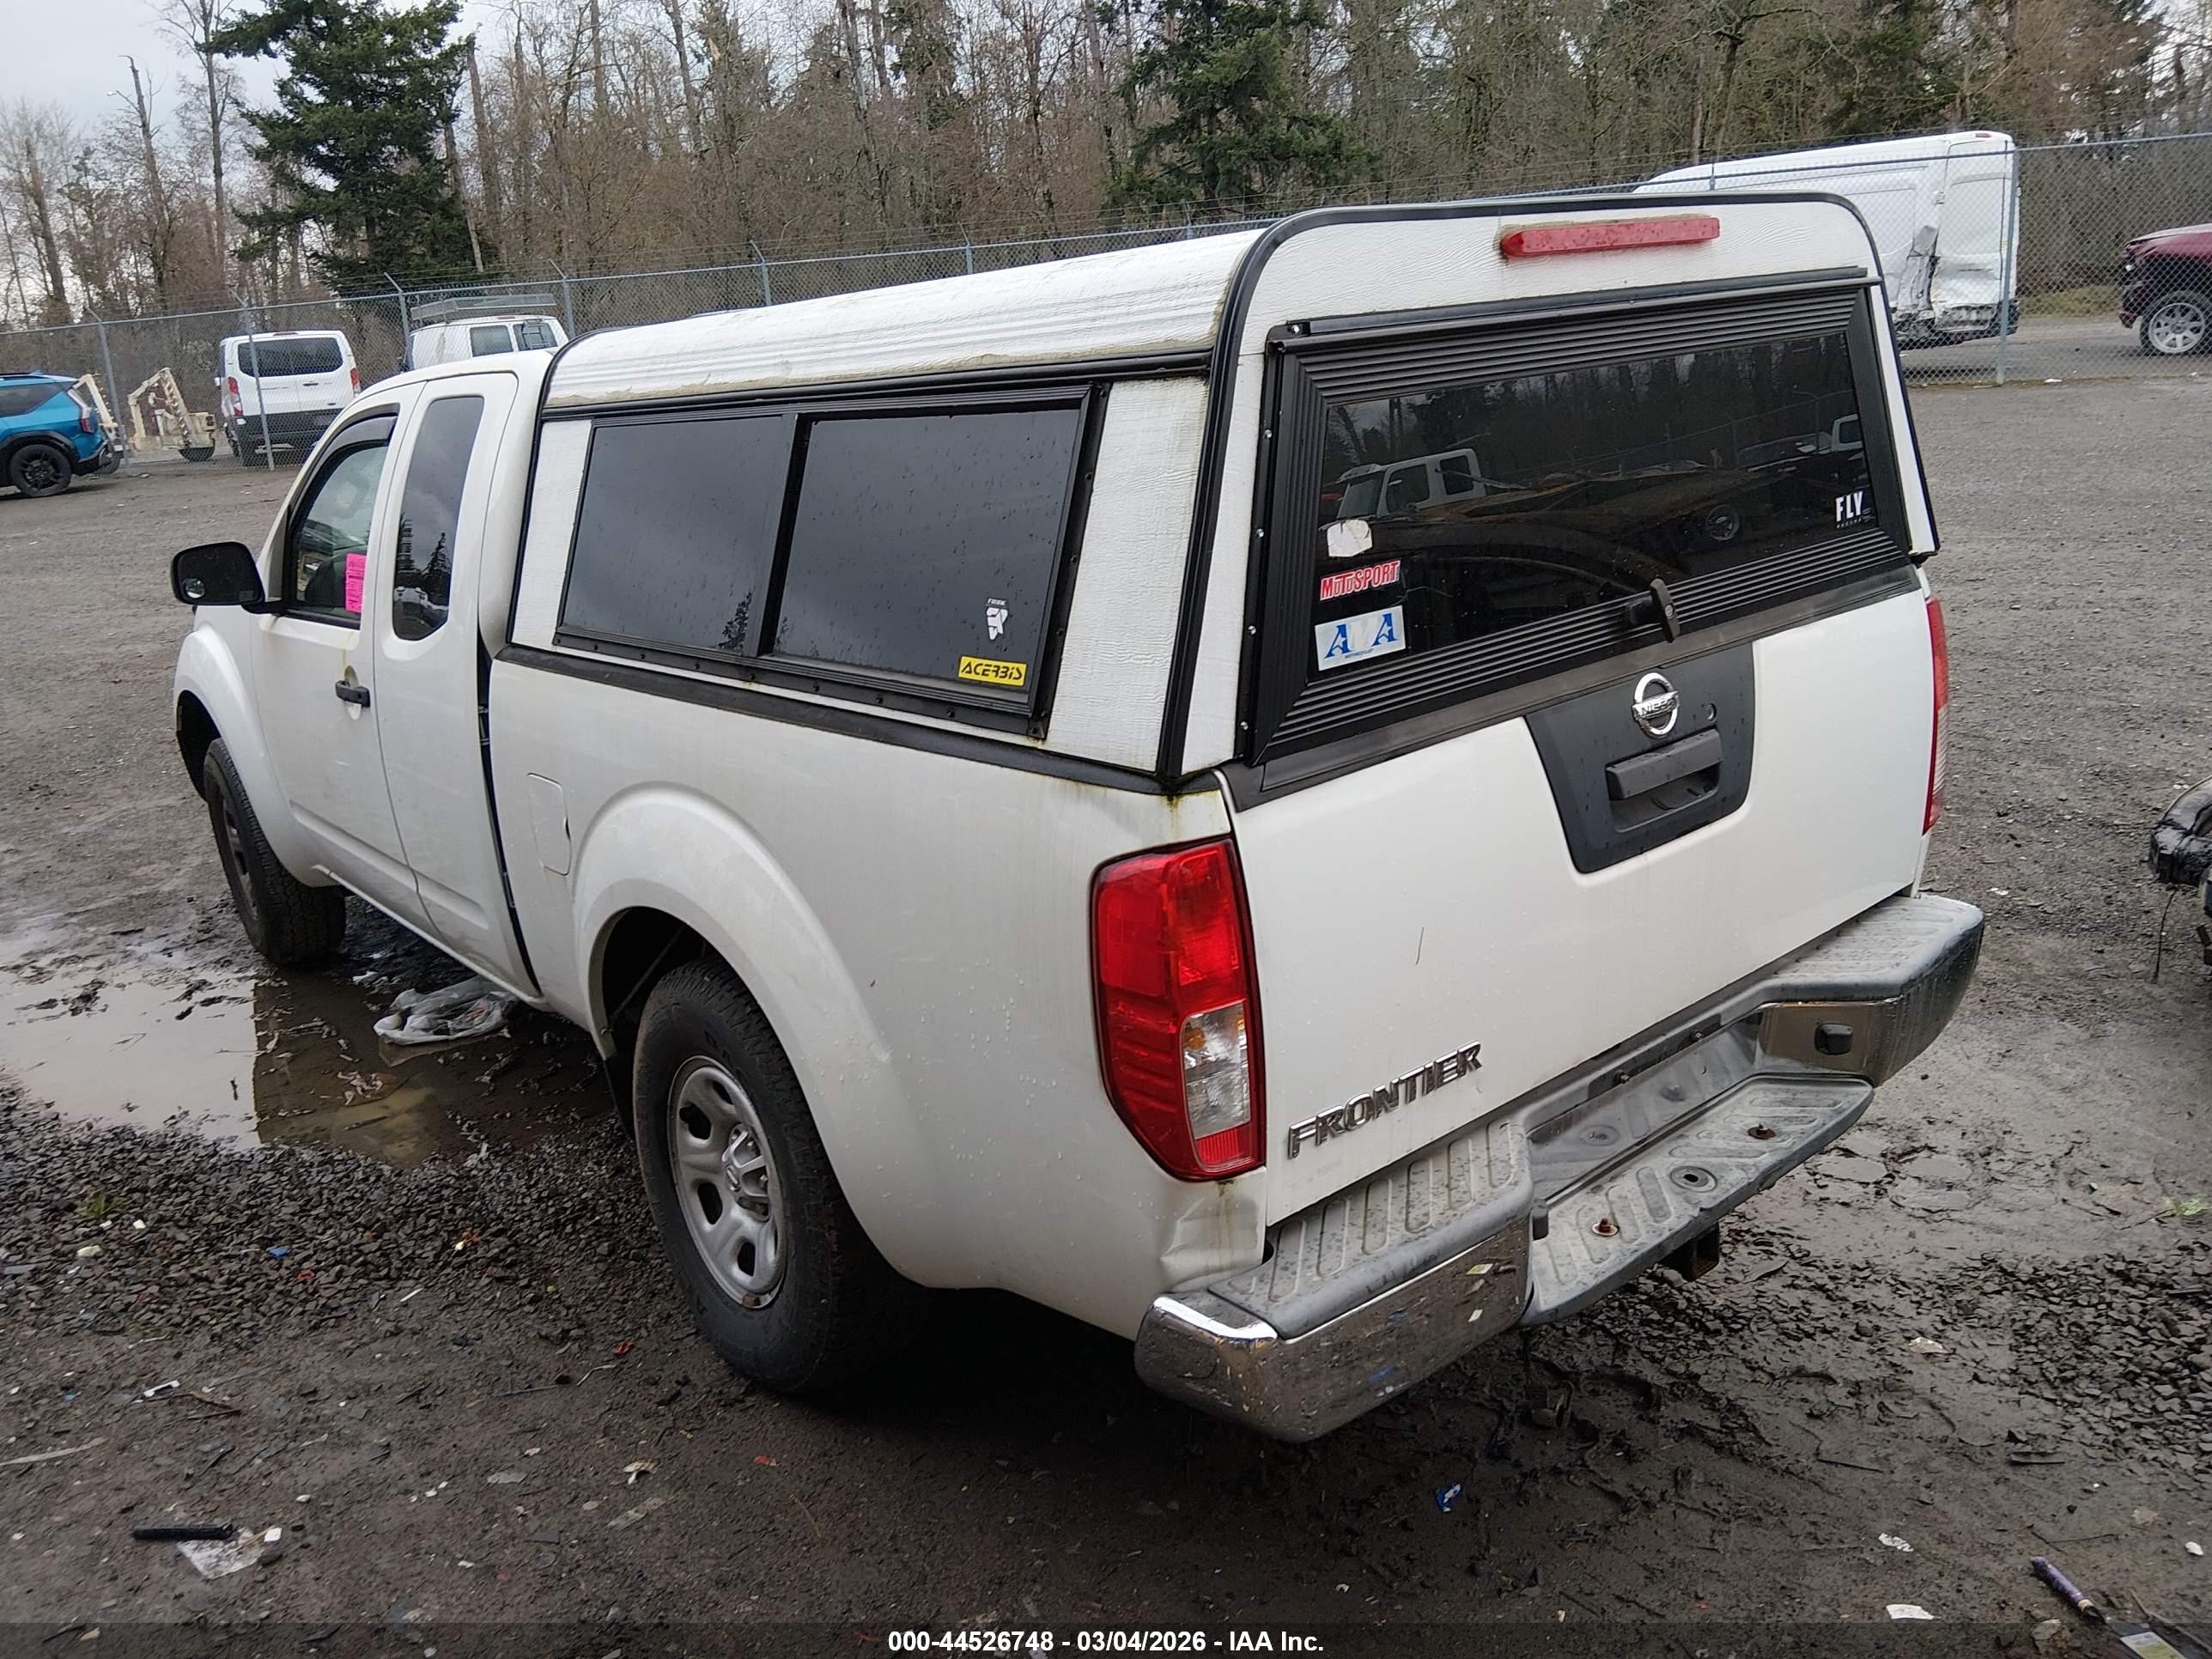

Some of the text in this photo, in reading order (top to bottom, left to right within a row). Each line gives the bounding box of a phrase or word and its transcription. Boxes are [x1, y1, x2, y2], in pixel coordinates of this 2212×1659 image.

[1836, 490, 1863, 522] FLY
[961, 661, 1023, 680] ACERBIS
[1288, 1040, 1483, 1159] FRONTIER
